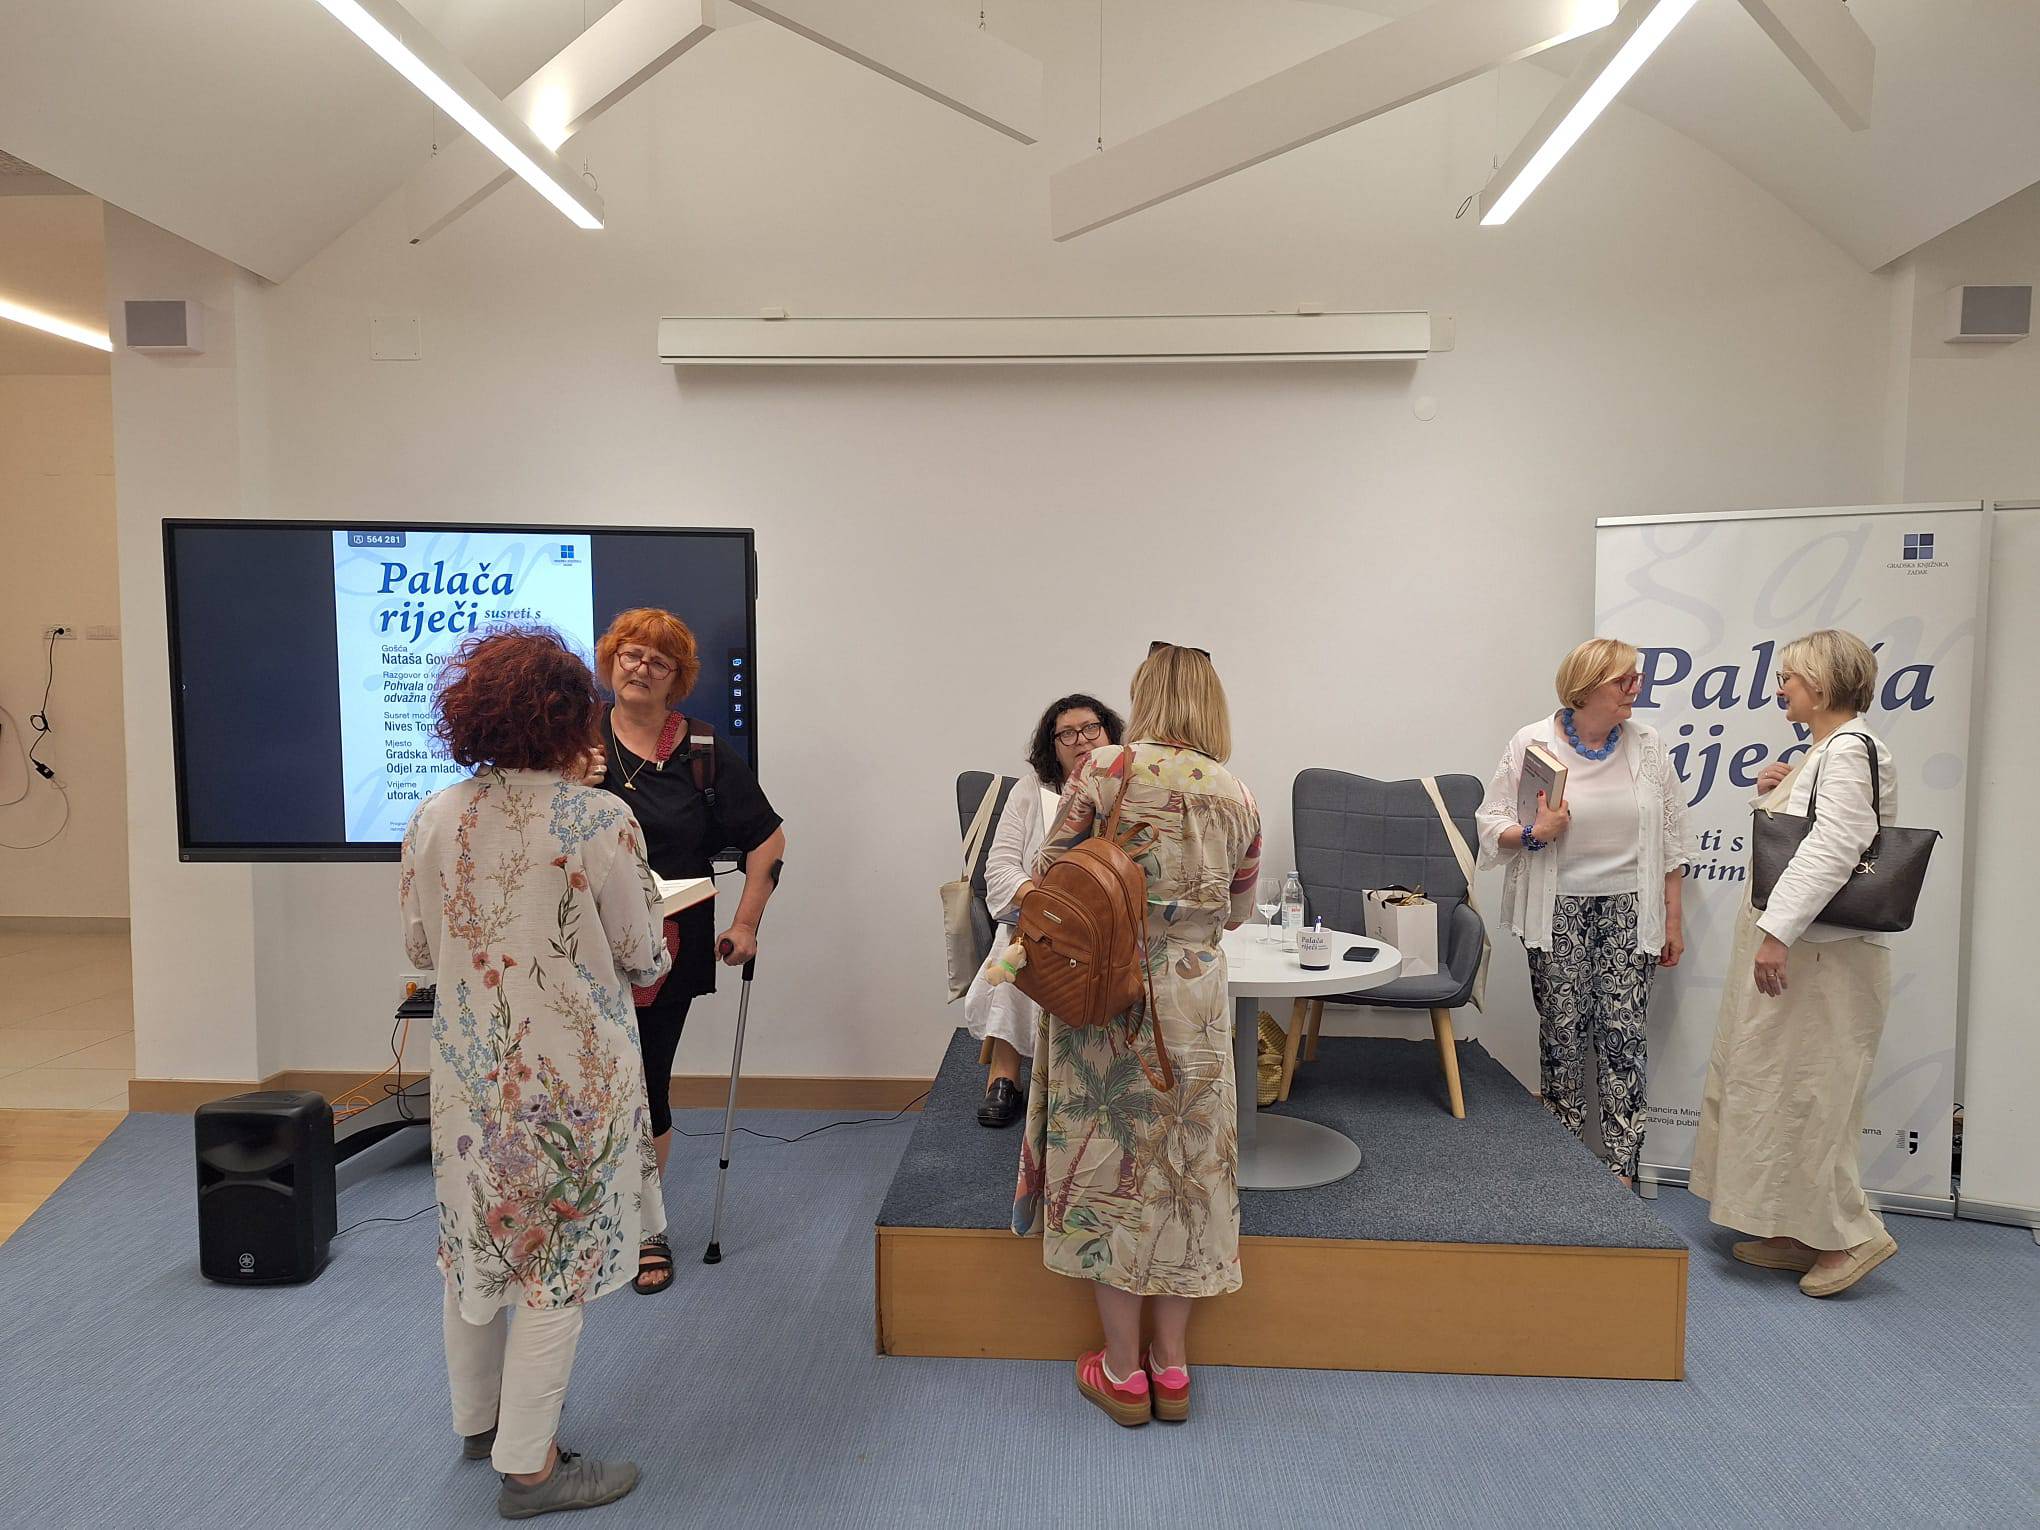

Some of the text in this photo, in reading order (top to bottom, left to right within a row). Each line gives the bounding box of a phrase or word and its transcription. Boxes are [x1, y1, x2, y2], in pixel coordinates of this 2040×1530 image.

[366, 535, 401, 544] 564 281
[377, 560, 514, 595] Palača
[484, 607, 542, 619] susreti s
[380, 600, 478, 643] riječi
[381, 644, 408, 653] Gošća
[382, 653, 423, 665] Nataša
[383, 671, 421, 681] Razgovor
[1633, 640, 1935, 711] Pala
[383, 681, 424, 691] Pohvala
[383, 691, 427, 703] odvažna
[383, 711, 410, 719] Susret
[384, 721, 413, 731] Nives
[385, 740, 412, 748] Mjesto
[386, 749, 428, 760] Gradska
[386, 763, 461, 775] Odjel za mlade
[387, 781, 417, 789] Vrijeme
[1730, 835, 1744, 852] s
